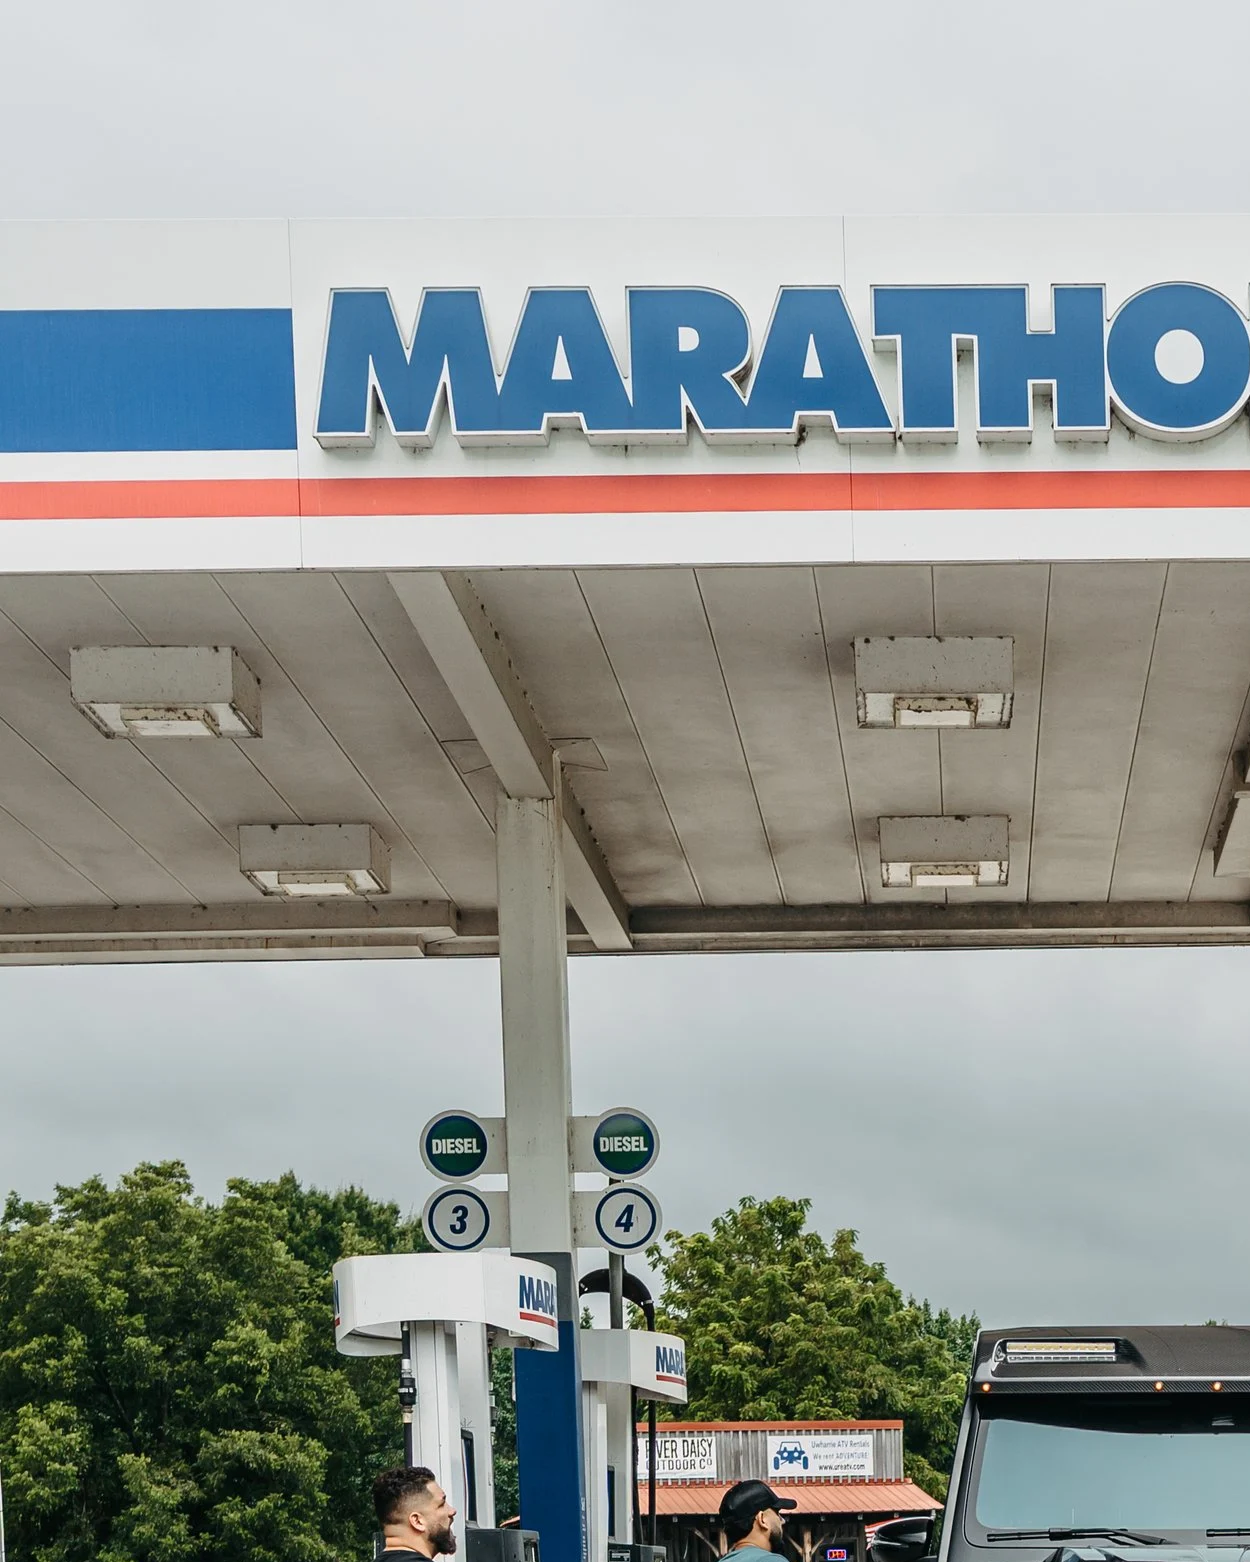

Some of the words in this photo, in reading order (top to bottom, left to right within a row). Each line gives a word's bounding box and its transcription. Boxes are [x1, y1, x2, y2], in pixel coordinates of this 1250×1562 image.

[431, 1138, 481, 1155] DIESEL
[599, 1136, 649, 1152] DIESEL
[449, 1205, 469, 1235] 3
[614, 1204, 635, 1233] 4
[682, 1438, 713, 1458] DAISY
[837, 1440, 848, 1448] ATV
[850, 1440, 870, 1448] Rentals
